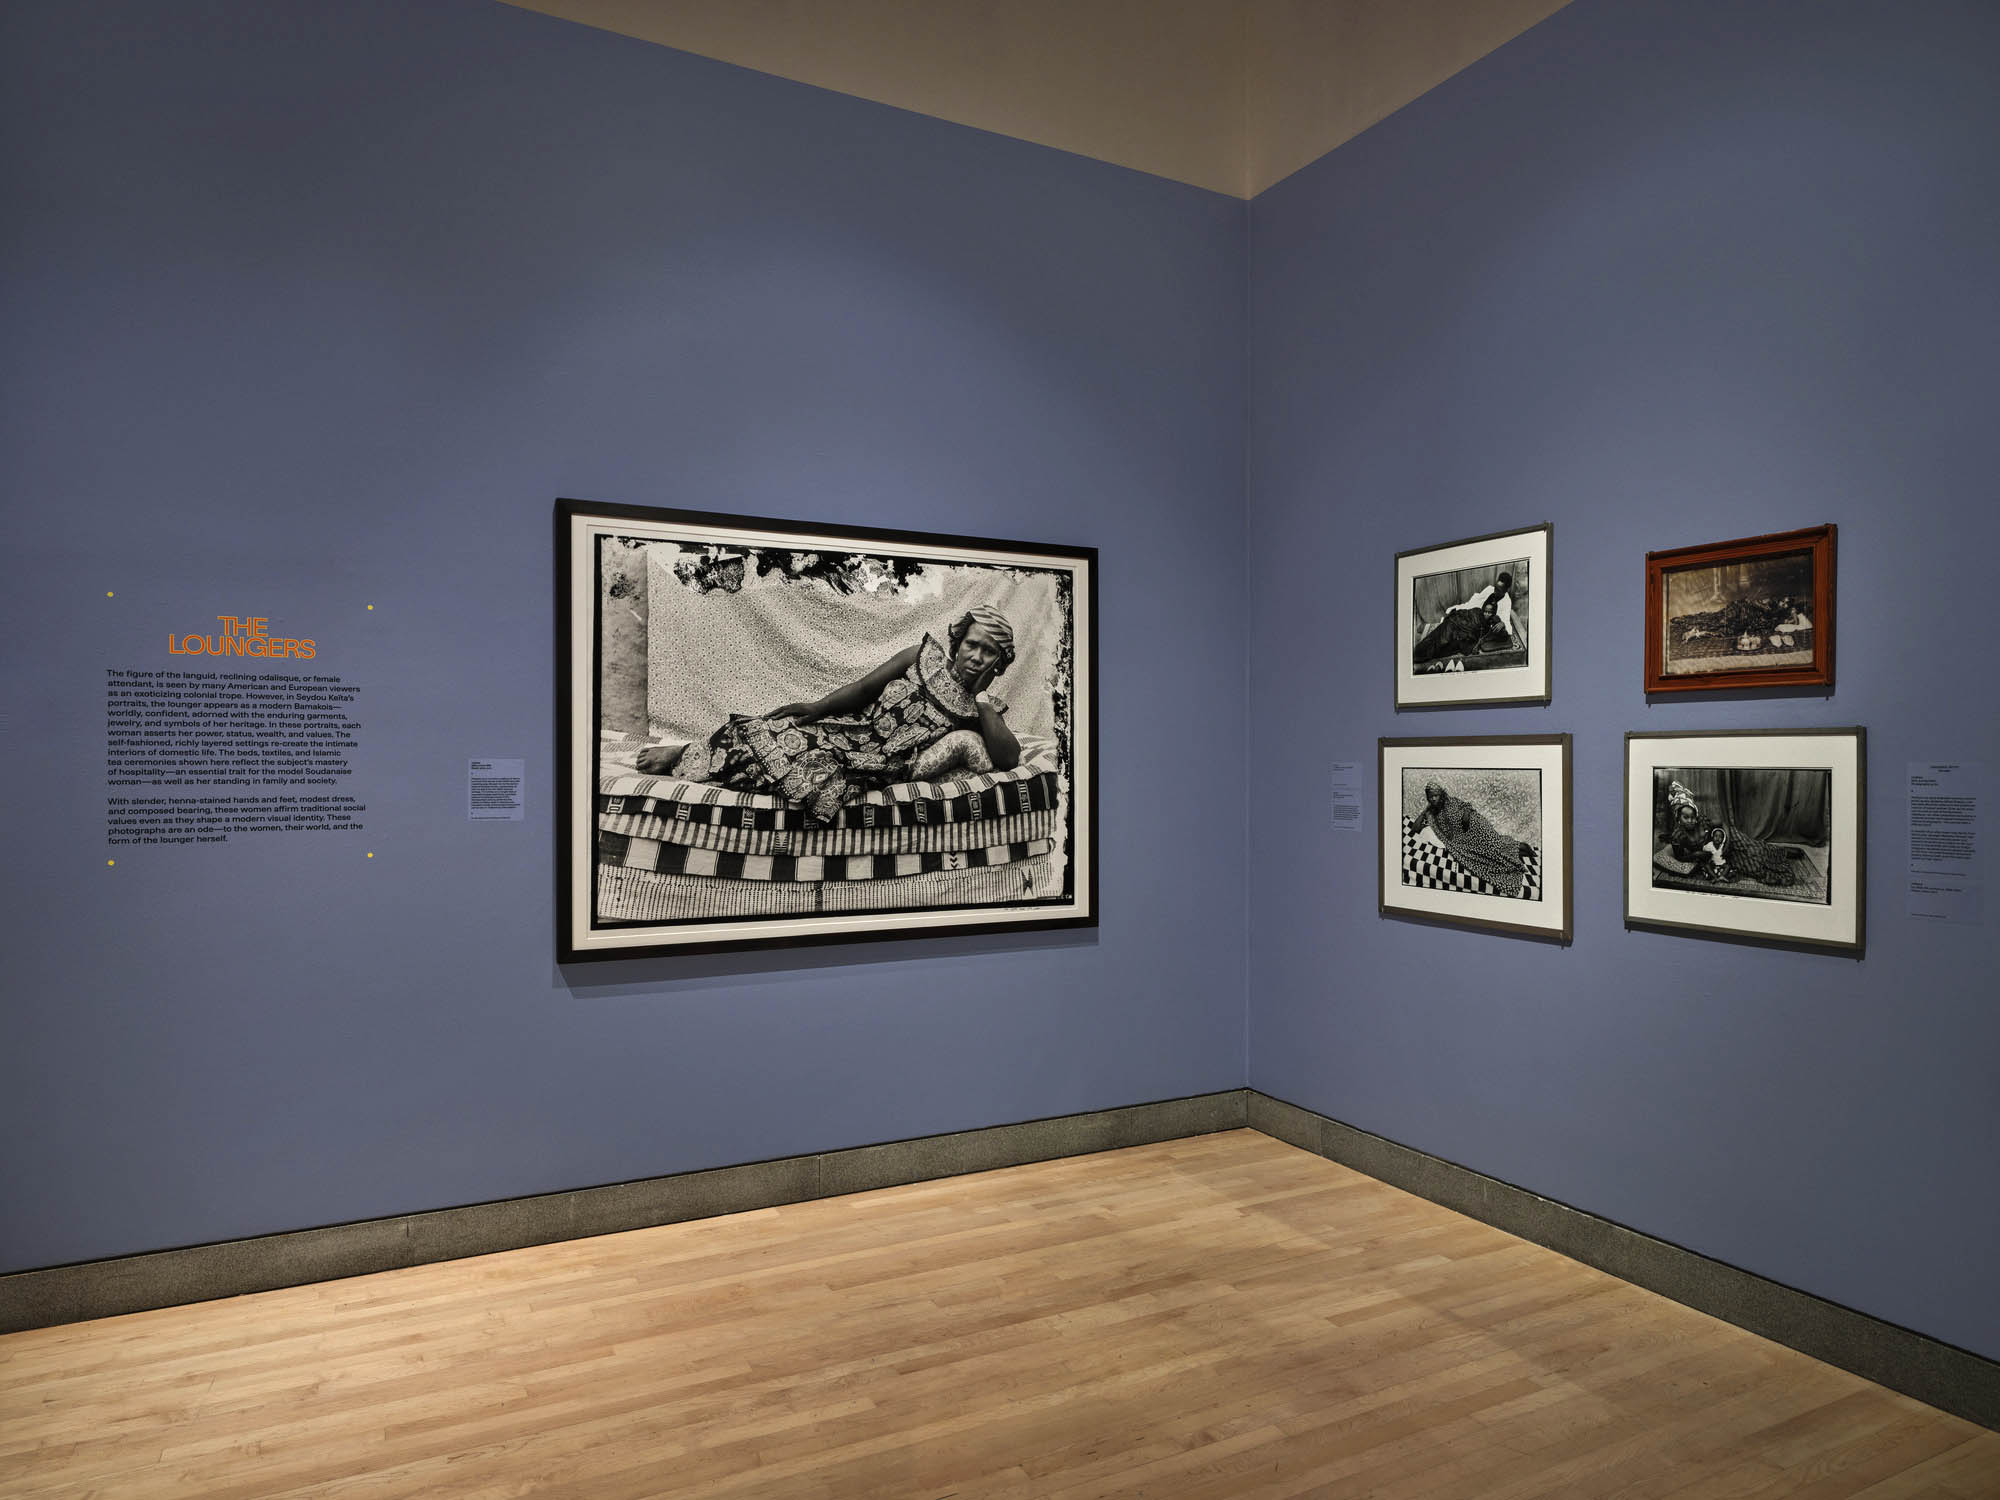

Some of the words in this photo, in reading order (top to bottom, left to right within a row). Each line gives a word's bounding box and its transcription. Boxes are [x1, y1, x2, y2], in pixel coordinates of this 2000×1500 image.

[217, 616, 268, 637] THE
[169, 634, 316, 659] LOUNGERS
[106, 669, 124, 678] The
[126, 670, 153, 680] figure
[155, 670, 165, 679] of
[166, 671, 181, 679] the
[182, 671, 218, 682] languid,
[219, 672, 258, 683] reclining
[258, 673, 301, 684] odalisque,
[313, 674, 341, 683] female
[108, 679, 154, 689] attendant,
[156, 680, 165, 688] is
[189, 681, 200, 691] by
[201, 683, 227, 692] many
[227, 682, 269, 691] American
[270, 683, 287, 691] and
[288, 683, 328, 694] European
[329, 684, 360, 693] viewers
[134, 689, 182, 700] exoticizing
[183, 690, 217, 699] colonial
[219, 691, 244, 701] trope.
[246, 691, 285, 701] However,
[286, 692, 295, 700] in
[296, 692, 327, 703] Seydou
[107, 700, 149, 710] portraits,
[150, 700, 167, 708] the
[166, 700, 202, 711] lounger
[203, 703, 238, 711] appears
[259, 701, 292, 710] modern
[107, 709, 143, 720] worldly,
[145, 710, 190, 719] confident,
[192, 710, 229, 718] adorned
[230, 710, 249, 719] with
[251, 711, 265, 719] the
[267, 711, 305, 721] enduring
[307, 711, 348, 722] garments,
[107, 719, 142, 729] jewelry,
[144, 719, 162, 727] and
[163, 719, 201, 730] symbols
[202, 720, 211, 728] of
[213, 720, 228, 728] her
[229, 720, 267, 730] heritage.
[268, 720, 277, 728] In
[278, 720, 302, 728] these
[303, 720, 340, 731] portraits,
[341, 721, 361, 729] each
[144, 729, 177, 737] asserts
[178, 729, 194, 737] her
[195, 731, 224, 739] power,
[226, 729, 255, 739] status,
[256, 729, 287, 739] wealth,
[288, 730, 304, 738] and
[305, 730, 334, 738] values.
[335, 730, 351, 738] The
[108, 738, 174, 748] self-fashioned,
[174, 738, 200, 749] richly
[201, 739, 233, 749] layered
[235, 739, 269, 749] settings
[271, 739, 309, 747] re-create
[309, 739, 324, 747] the
[325, 739, 358, 747] intimate
[108, 748, 146, 756] interiors
[147, 748, 157, 756] of
[158, 748, 200, 756] domestic
[201, 748, 217, 756] life.
[218, 748, 235, 756] The
[237, 748, 260, 758] beds,
[261, 748, 293, 758] textiles,
[295, 748, 311, 757] and
[312, 749, 341, 757] Islamic
[107, 758, 122, 766] tea
[124, 758, 177, 766] ceremonies
[178, 758, 208, 766] shown
[210, 758, 231, 766] here
[231, 758, 260, 766] reflect
[261, 758, 276, 766] the
[314, 758, 348, 768] mastery
[107, 768, 117, 776] of
[188, 767, 227, 775] essential
[228, 767, 246, 775] trait
[248, 767, 261, 775] for
[260, 767, 276, 775] the
[277, 767, 305, 775] model
[304, 767, 352, 775] Soudanaise
[164, 777, 182, 785] well
[196, 777, 211, 785] her
[213, 777, 251, 787] standing
[252, 777, 261, 785] in
[262, 777, 288, 787] family
[289, 777, 306, 785] and
[307, 777, 337, 787] society.
[107, 797, 130, 805] With
[131, 797, 167, 806] slender,
[168, 796, 231, 805] henna-stained
[233, 796, 260, 804] hands
[261, 796, 278, 804] and
[279, 795, 298, 805] feet,
[299, 795, 330, 803] modest
[331, 795, 356, 804] dress,
[108, 807, 126, 815] and
[127, 806, 175, 817] composed
[177, 806, 213, 816] bearing,
[214, 805, 239, 814] these
[274, 804, 299, 813] affirm
[300, 804, 342, 812] traditional
[343, 804, 366, 812] social
[108, 816, 137, 825] values
[175, 815, 195, 826] they
[196, 815, 223, 825] shape
[232, 814, 266, 823] modern
[266, 814, 291, 822] visual
[293, 813, 325, 824] identity.
[326, 813, 351, 821] These
[108, 826, 166, 837] photographs
[233, 824, 248, 832] the
[249, 825, 283, 833] women,
[284, 823, 305, 832] their
[305, 823, 331, 832] world,
[332, 822, 348, 831] and
[349, 822, 363, 830] the
[108, 836, 130, 844] form
[132, 836, 141, 844] of
[143, 835, 158, 844] the
[160, 835, 195, 845] lounger
[196, 834, 228, 843] herself.
